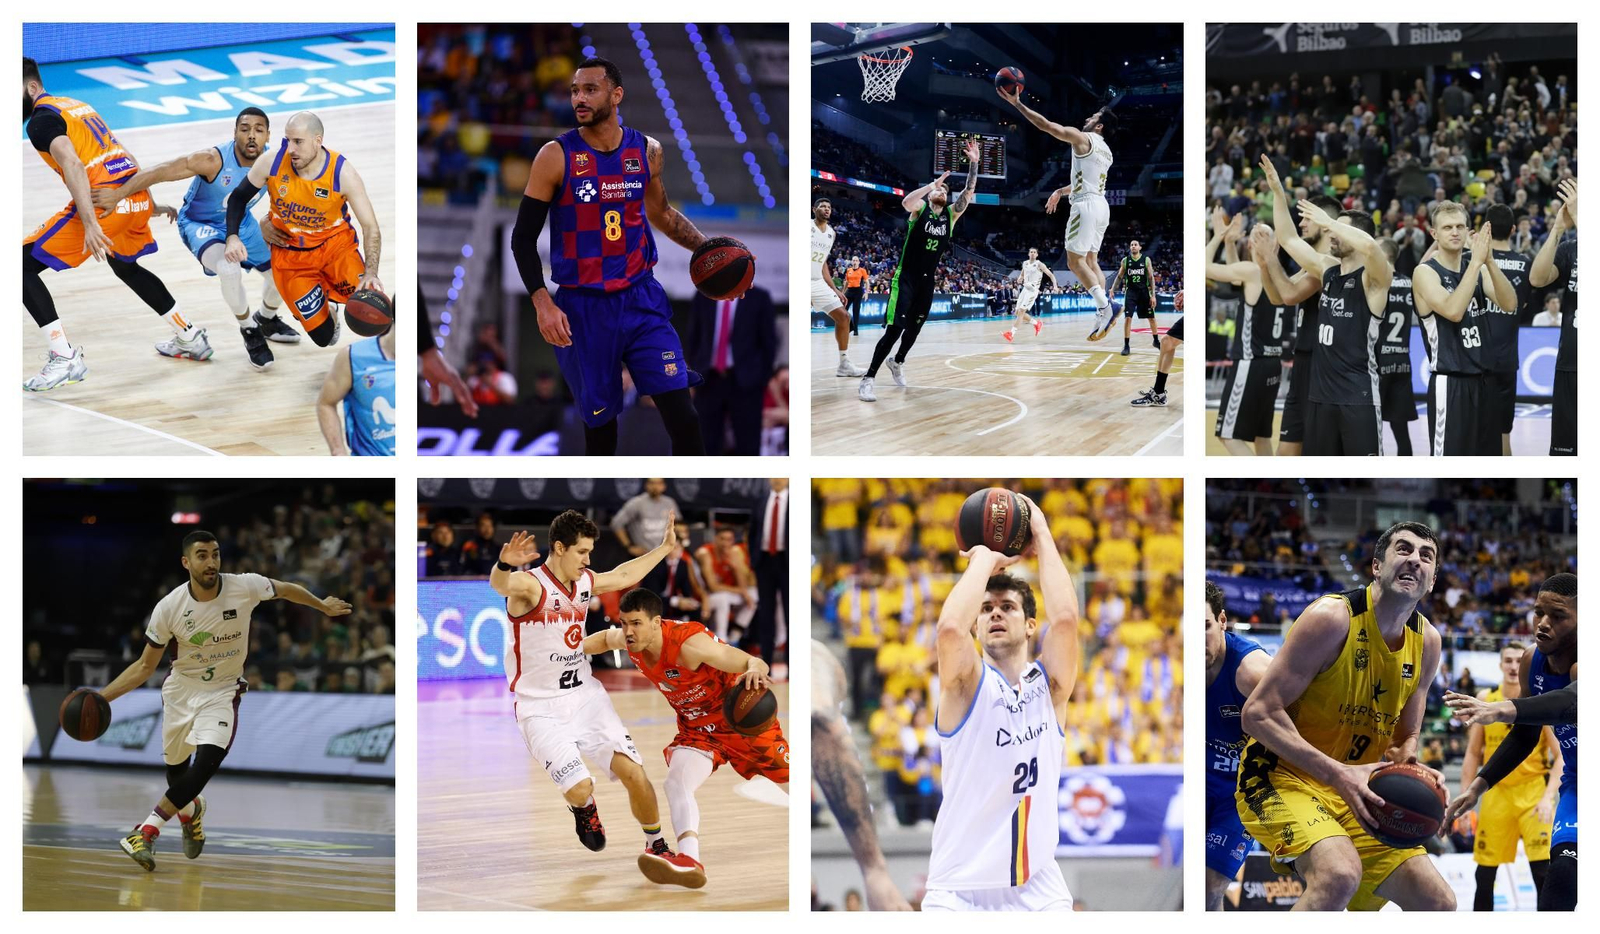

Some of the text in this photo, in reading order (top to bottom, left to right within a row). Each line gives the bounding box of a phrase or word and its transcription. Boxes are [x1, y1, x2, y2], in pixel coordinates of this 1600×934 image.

[1297, 36, 1346, 52] Bilbao
[1410, 28, 1462, 45] Bilbao
[602, 180, 643, 190] Assistència
[602, 189, 632, 200] Sanitària
[275, 198, 317, 214] Cultura
[604, 210, 622, 241] 8
[926, 238, 939, 251] 32
[811, 251, 825, 264] 22
[1132, 275, 1141, 283] 22
[297, 286, 322, 309] PULEVA
[1272, 307, 1285, 339] 5
[1386, 311, 1405, 342] 2
[1319, 323, 1334, 346] 10
[1461, 325, 1482, 348] 33
[212, 631, 242, 643] Unicaja
[559, 669, 583, 689] 21
